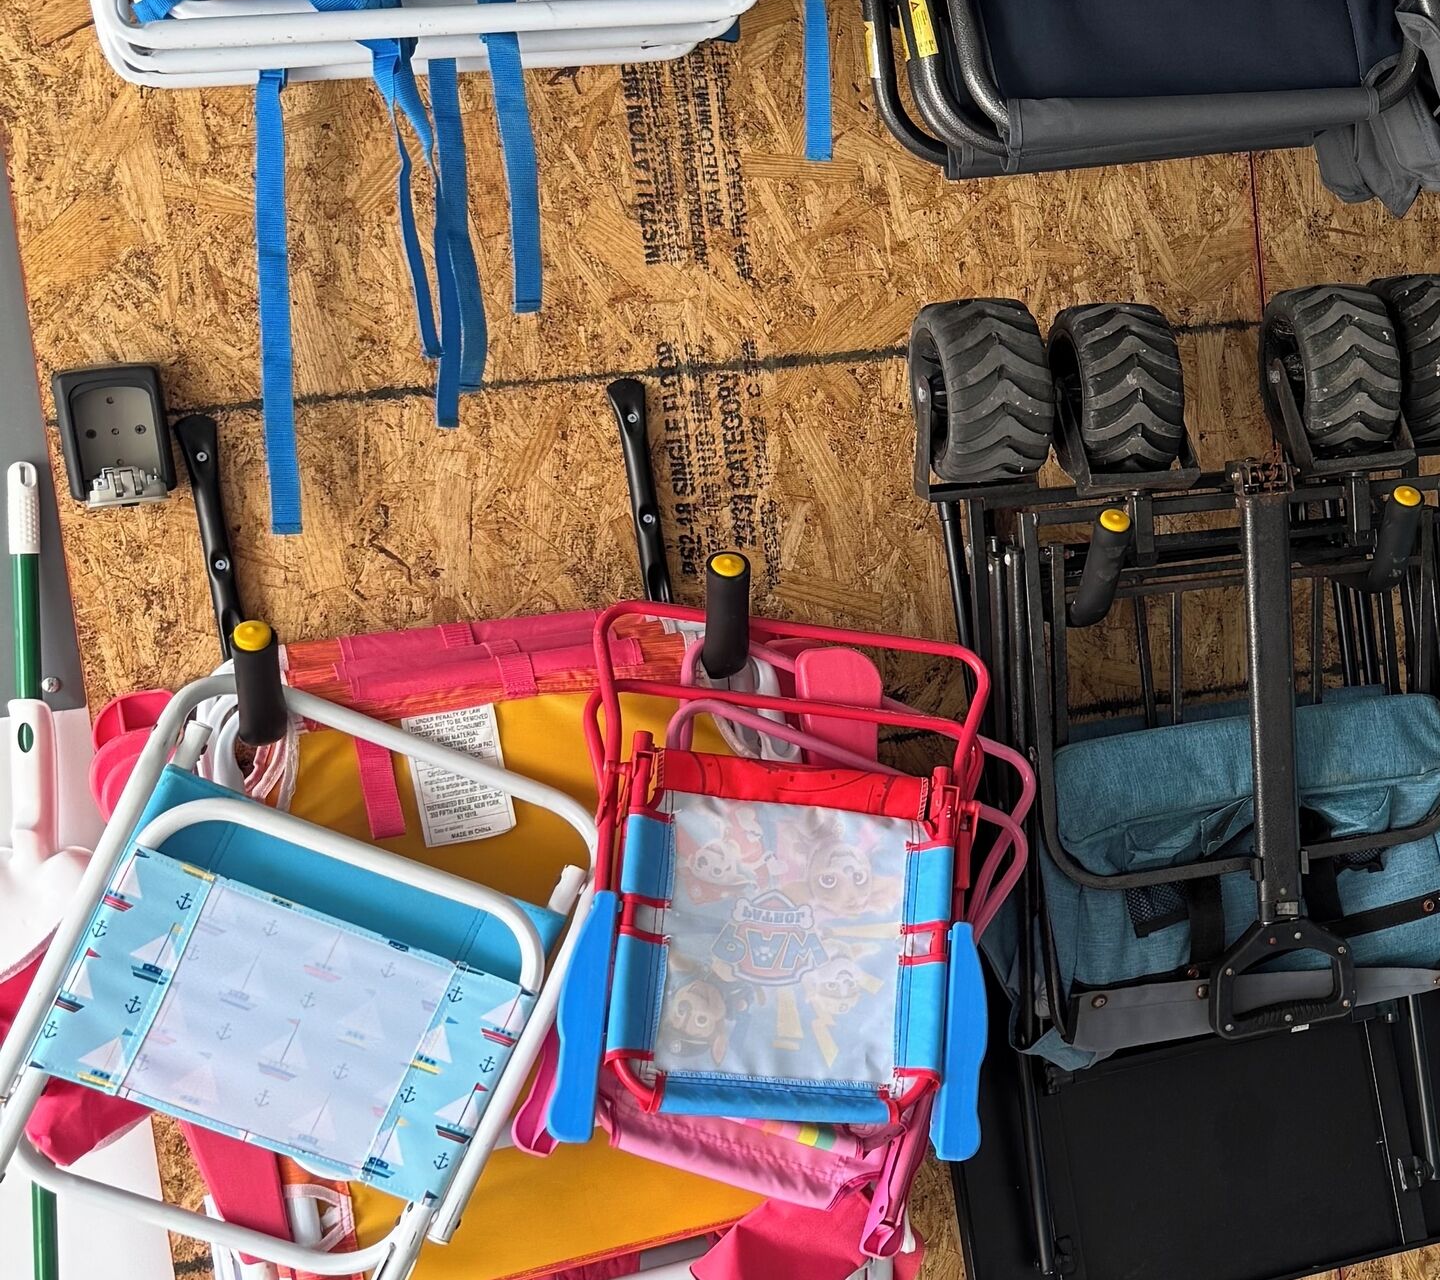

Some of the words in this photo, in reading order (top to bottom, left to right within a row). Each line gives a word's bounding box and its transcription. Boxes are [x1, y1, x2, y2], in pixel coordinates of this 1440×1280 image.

[717, 373, 750, 489] CATEGORY
[436, 712, 459, 722] PENALTY
[462, 713, 488, 723] REMOVED
[445, 726, 455, 734] THE
[456, 721, 486, 731] CONSUMER
[452, 731, 479, 740] MATERIAL
[451, 831, 467, 839] MADE
[475, 826, 492, 834] CHINA
